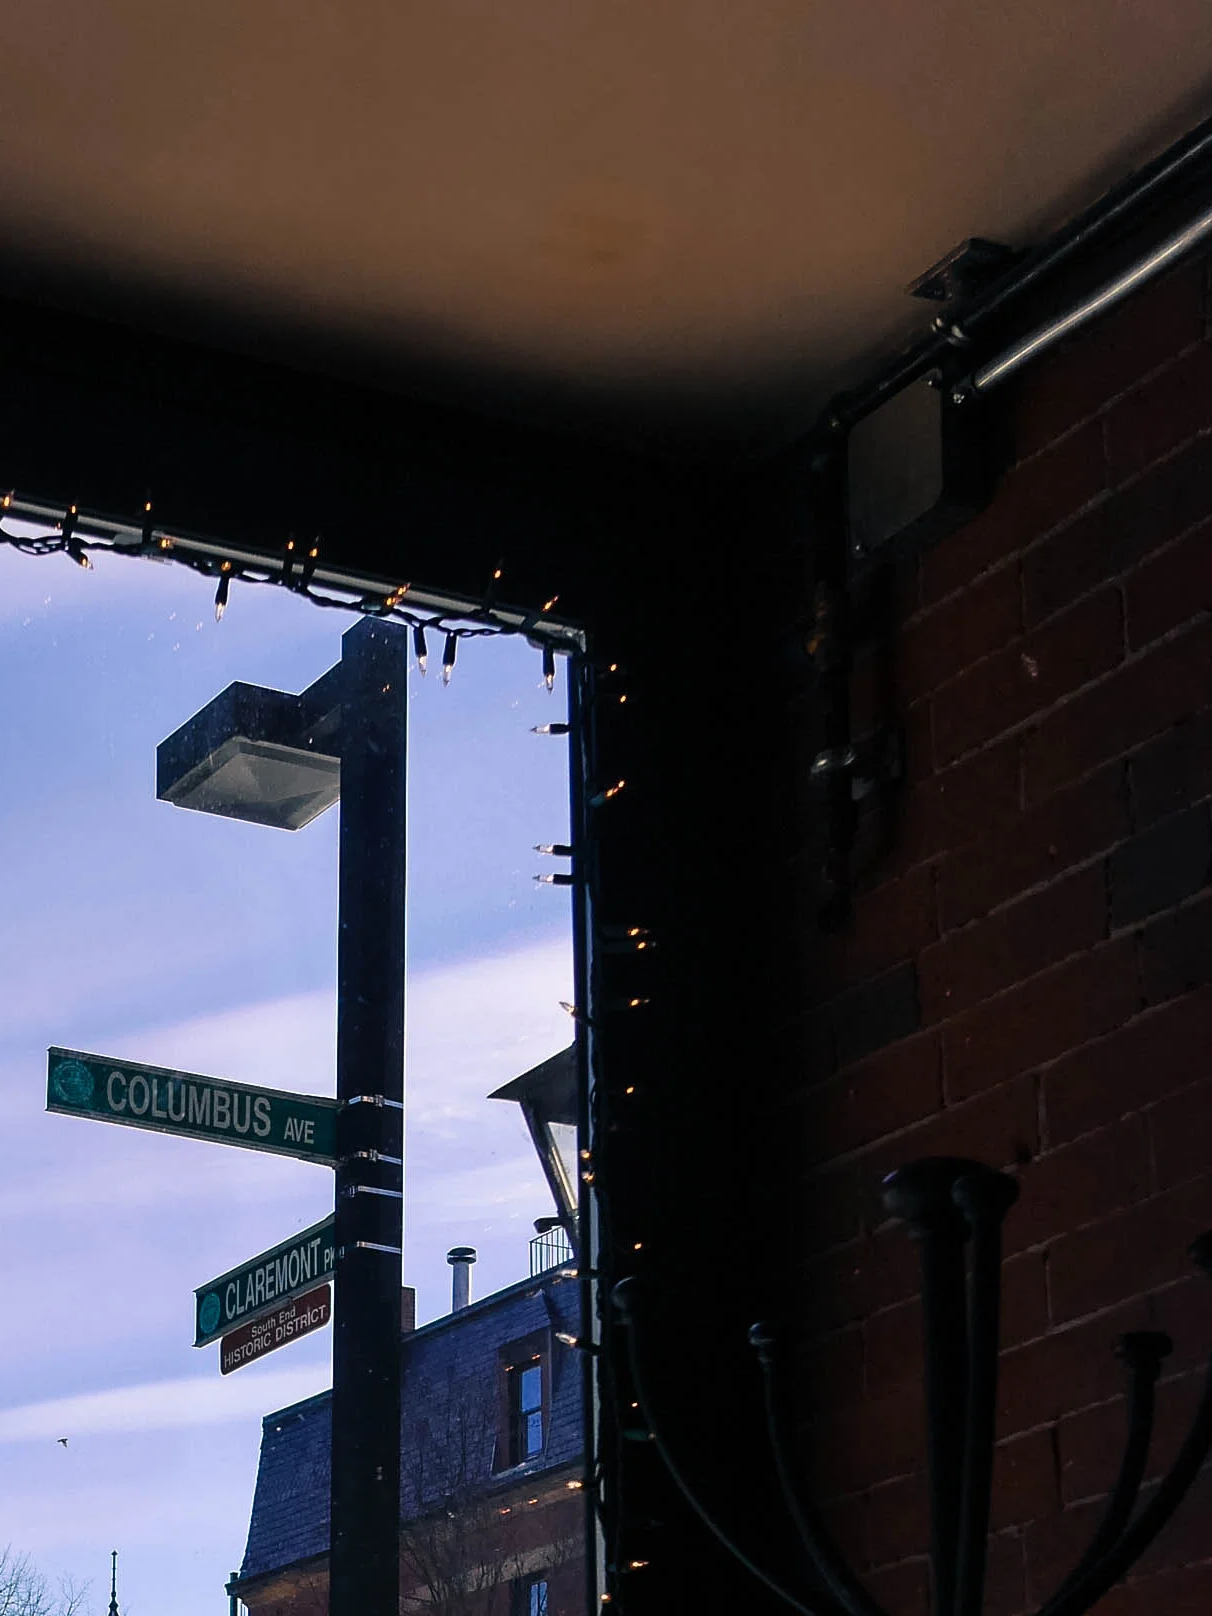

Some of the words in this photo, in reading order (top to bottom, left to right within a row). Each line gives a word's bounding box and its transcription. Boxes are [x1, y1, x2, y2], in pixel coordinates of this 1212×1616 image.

[106, 1071, 272, 1137] COLUMBUS
[284, 1117, 315, 1145] AVE
[225, 1238, 321, 1319] CLAREMONT
[224, 1332, 271, 1369] HISTORIC
[275, 1304, 326, 1344] DISTRICT
[251, 1317, 277, 1338] South
[279, 1306, 296, 1325] End
